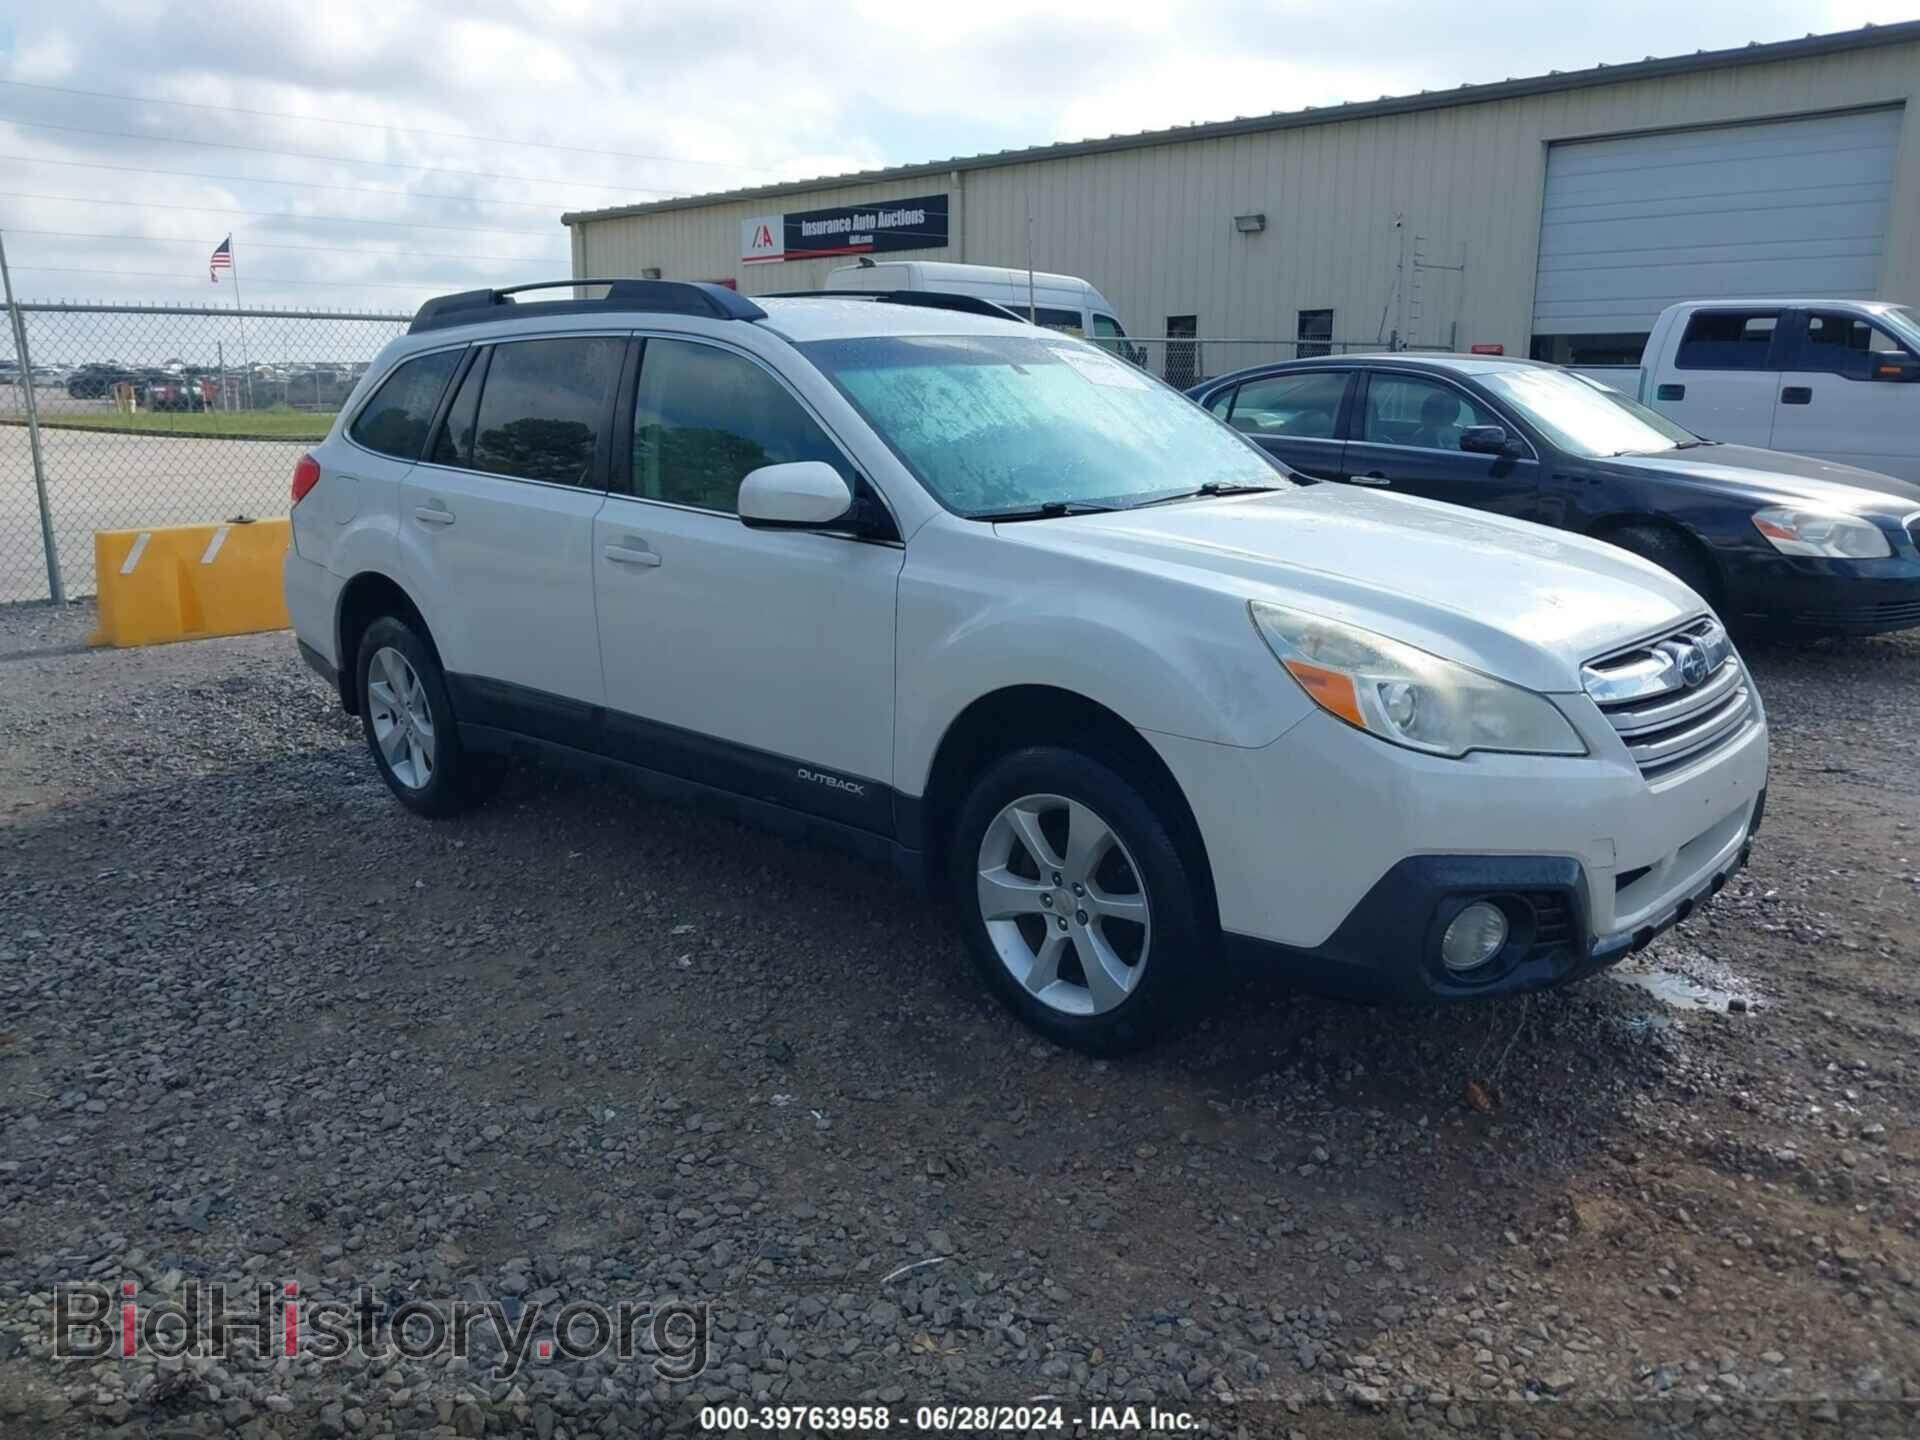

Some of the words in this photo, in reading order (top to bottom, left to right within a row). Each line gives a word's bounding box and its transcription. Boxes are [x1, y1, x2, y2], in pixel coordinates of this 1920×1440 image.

[802, 219, 851, 236] Insurance
[852, 214, 875, 231] Auto
[878, 208, 925, 226] Auctions
[797, 768, 864, 796] OUTBACK
